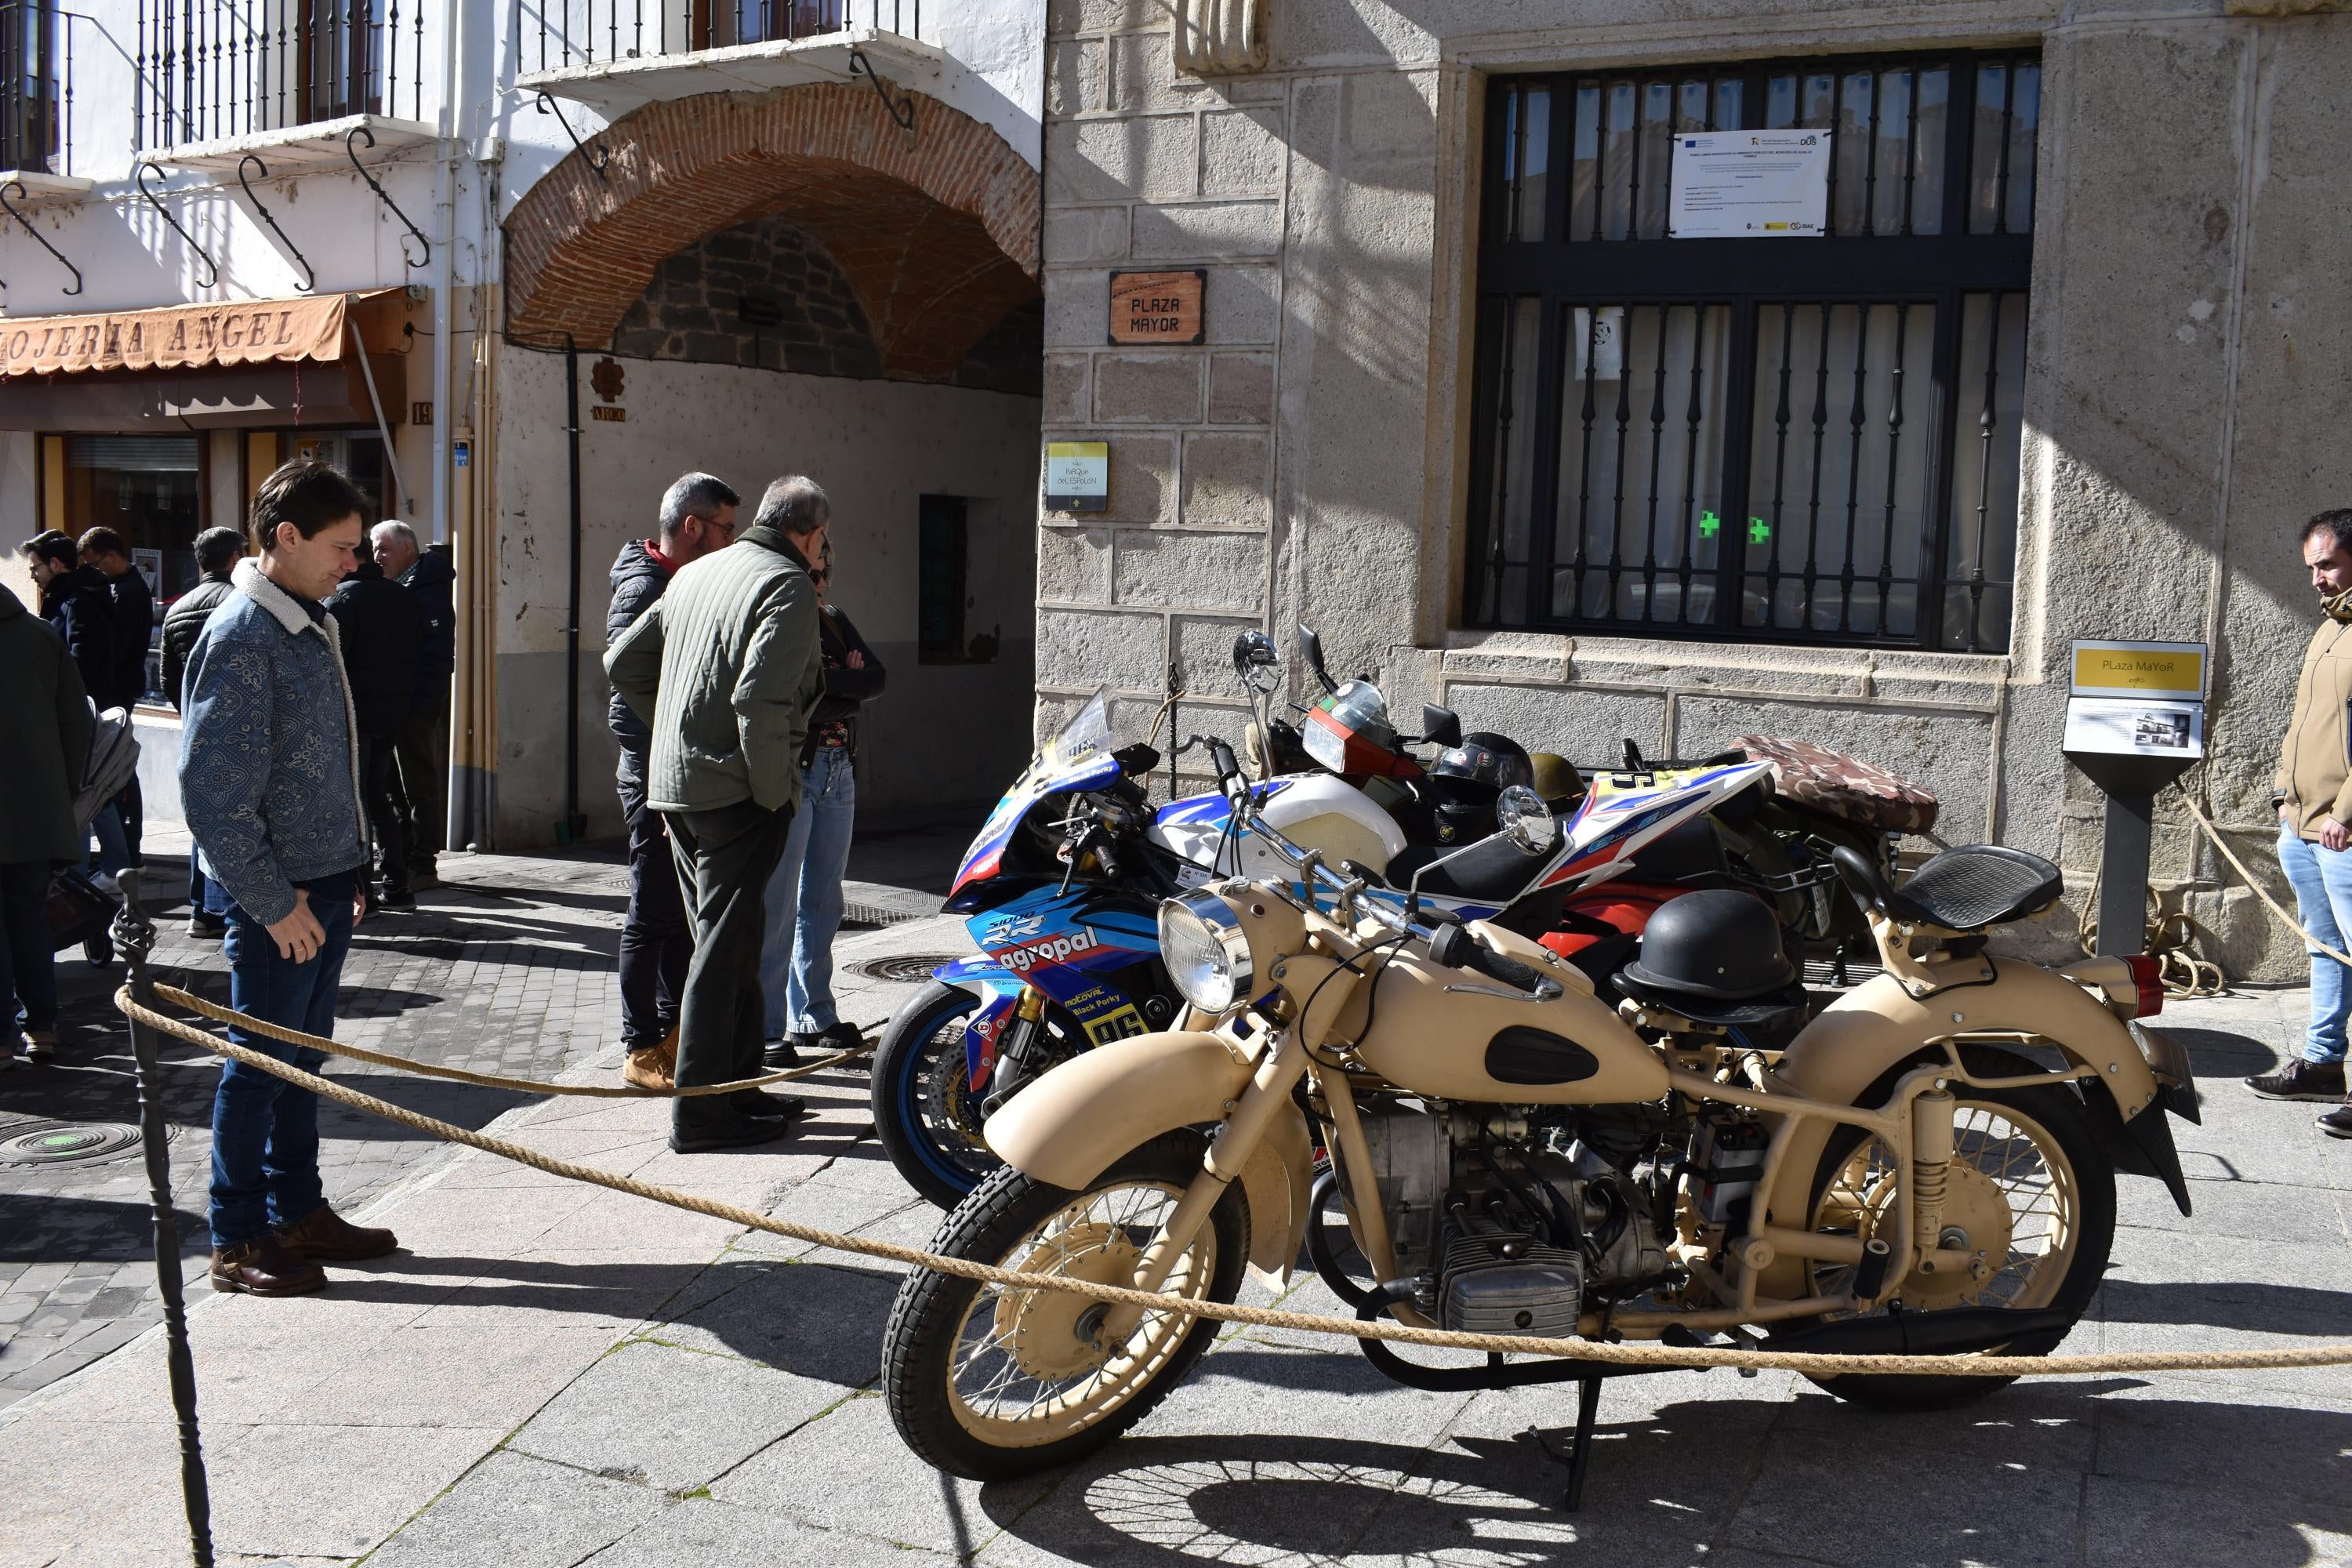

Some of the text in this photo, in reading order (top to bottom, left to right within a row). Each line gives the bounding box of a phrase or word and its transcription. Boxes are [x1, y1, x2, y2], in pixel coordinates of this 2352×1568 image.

[1131, 299, 1180, 313] PLAZA
[0, 311, 293, 360] OJERIA ANGEL
[1131, 318, 1179, 332] MAYOR
[414, 403, 432, 423] 19
[1091, 765, 1113, 776] Porky
[982, 914, 1047, 946] RR
[1000, 925, 1098, 971] agropal
[1073, 994, 1120, 1016] Black Porky
[1092, 1011, 1145, 1046] 96
